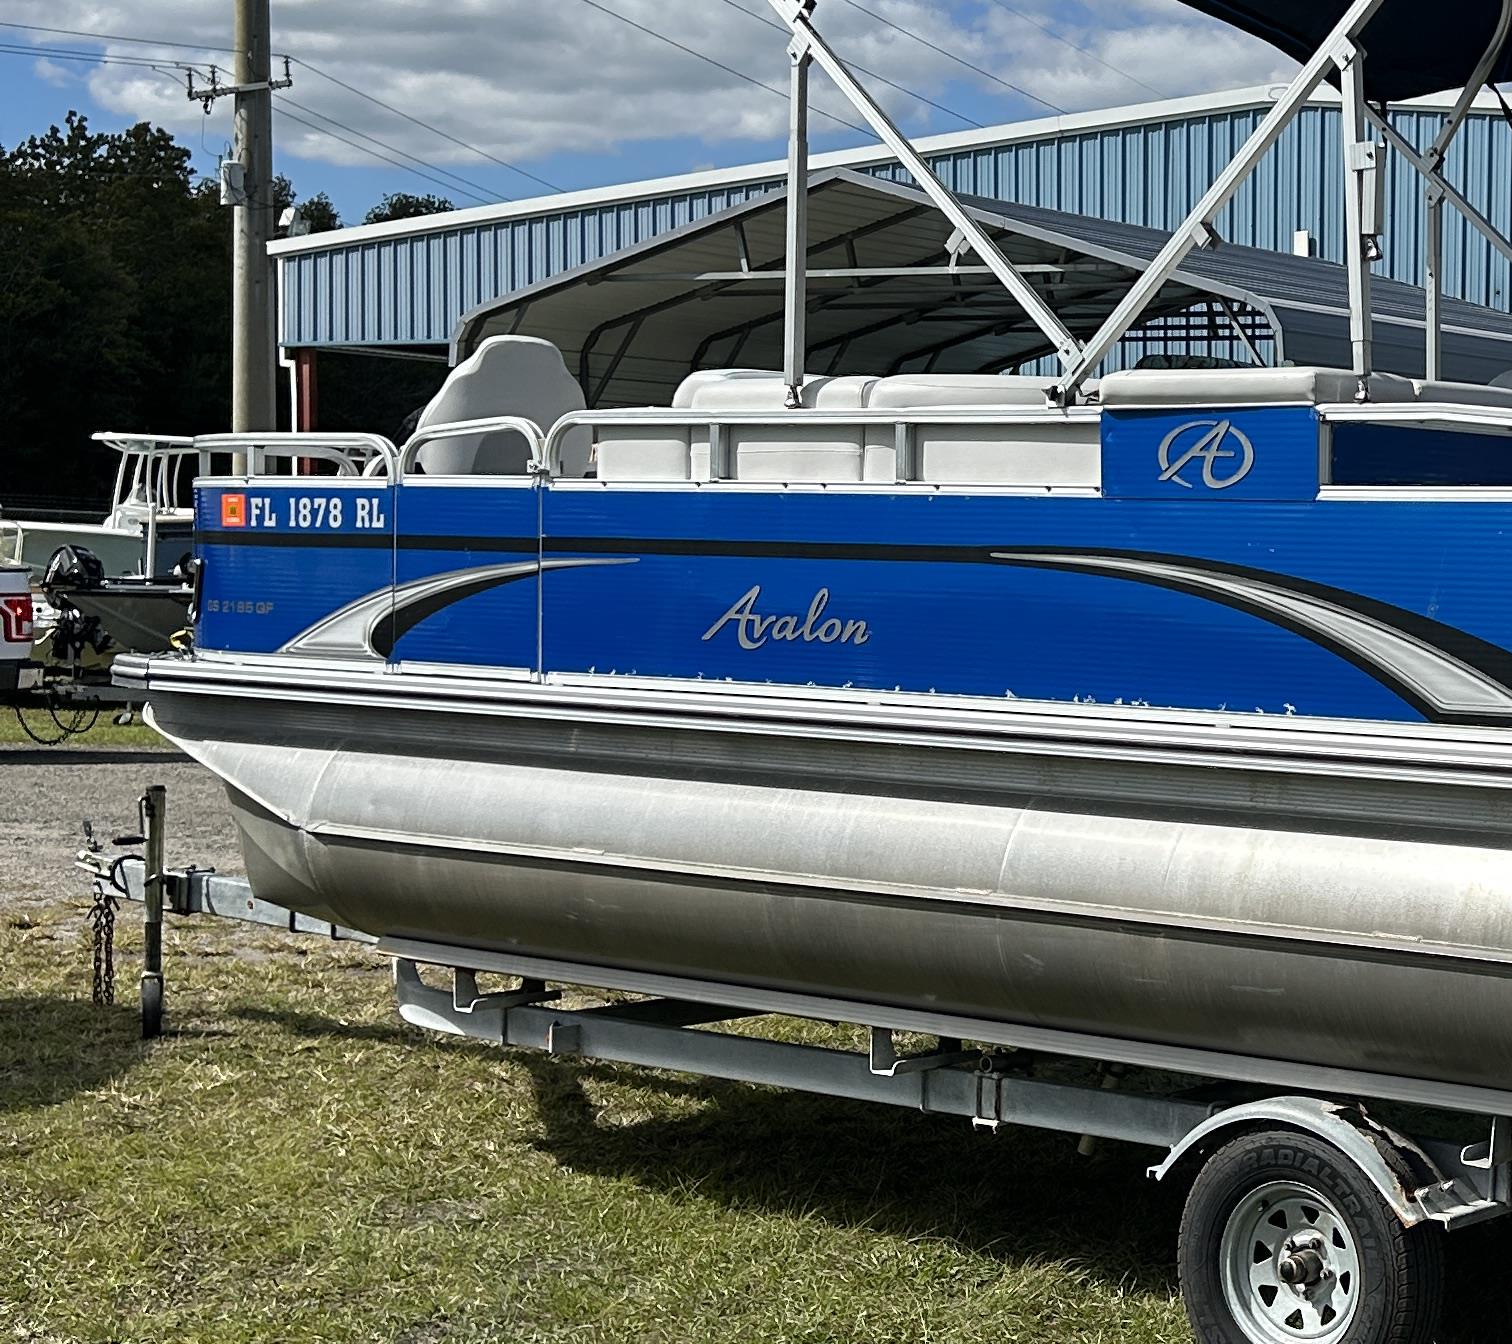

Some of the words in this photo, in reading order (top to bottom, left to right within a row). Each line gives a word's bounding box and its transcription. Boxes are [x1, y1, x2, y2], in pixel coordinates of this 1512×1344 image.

[250, 497, 277, 528] FL
[288, 497, 343, 529] 1878
[355, 497, 385, 529] RL
[702, 585, 869, 650] Avalon
